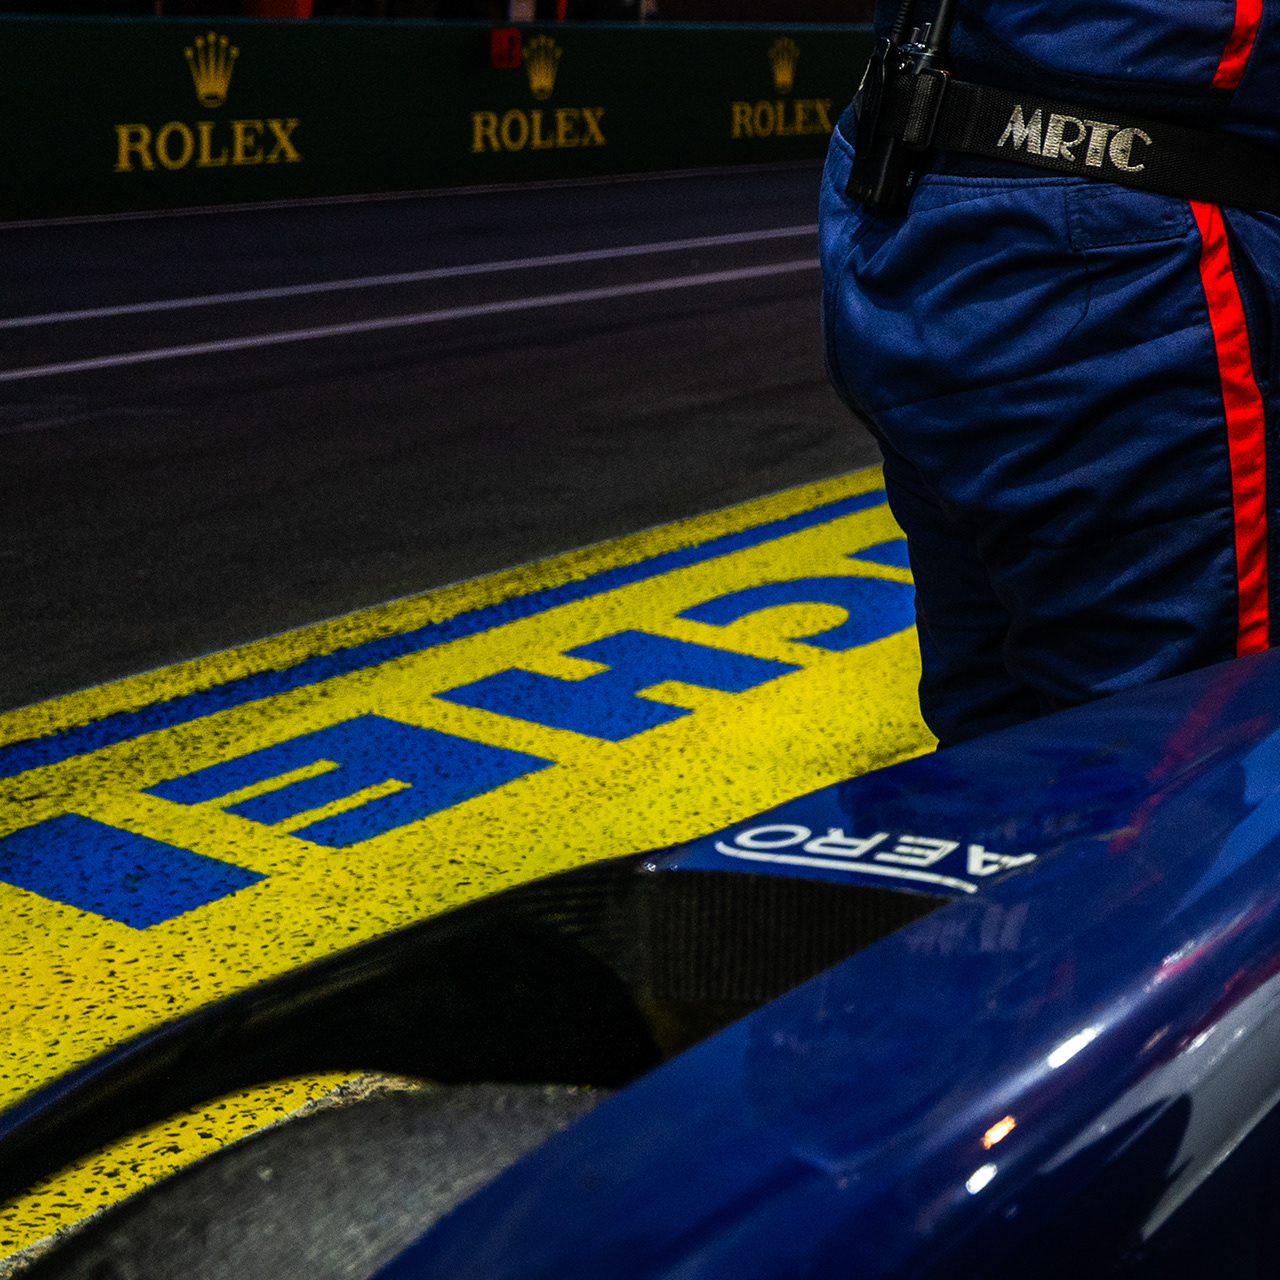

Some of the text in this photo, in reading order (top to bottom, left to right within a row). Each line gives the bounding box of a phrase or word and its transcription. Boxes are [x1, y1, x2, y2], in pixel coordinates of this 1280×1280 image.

[113, 118, 302, 173] ROLEX
[470, 107, 606, 153] ROLEX
[731, 99, 833, 139] ROLEX
[997, 104, 1152, 173] MRTC
[733, 823, 1038, 877] AERO
